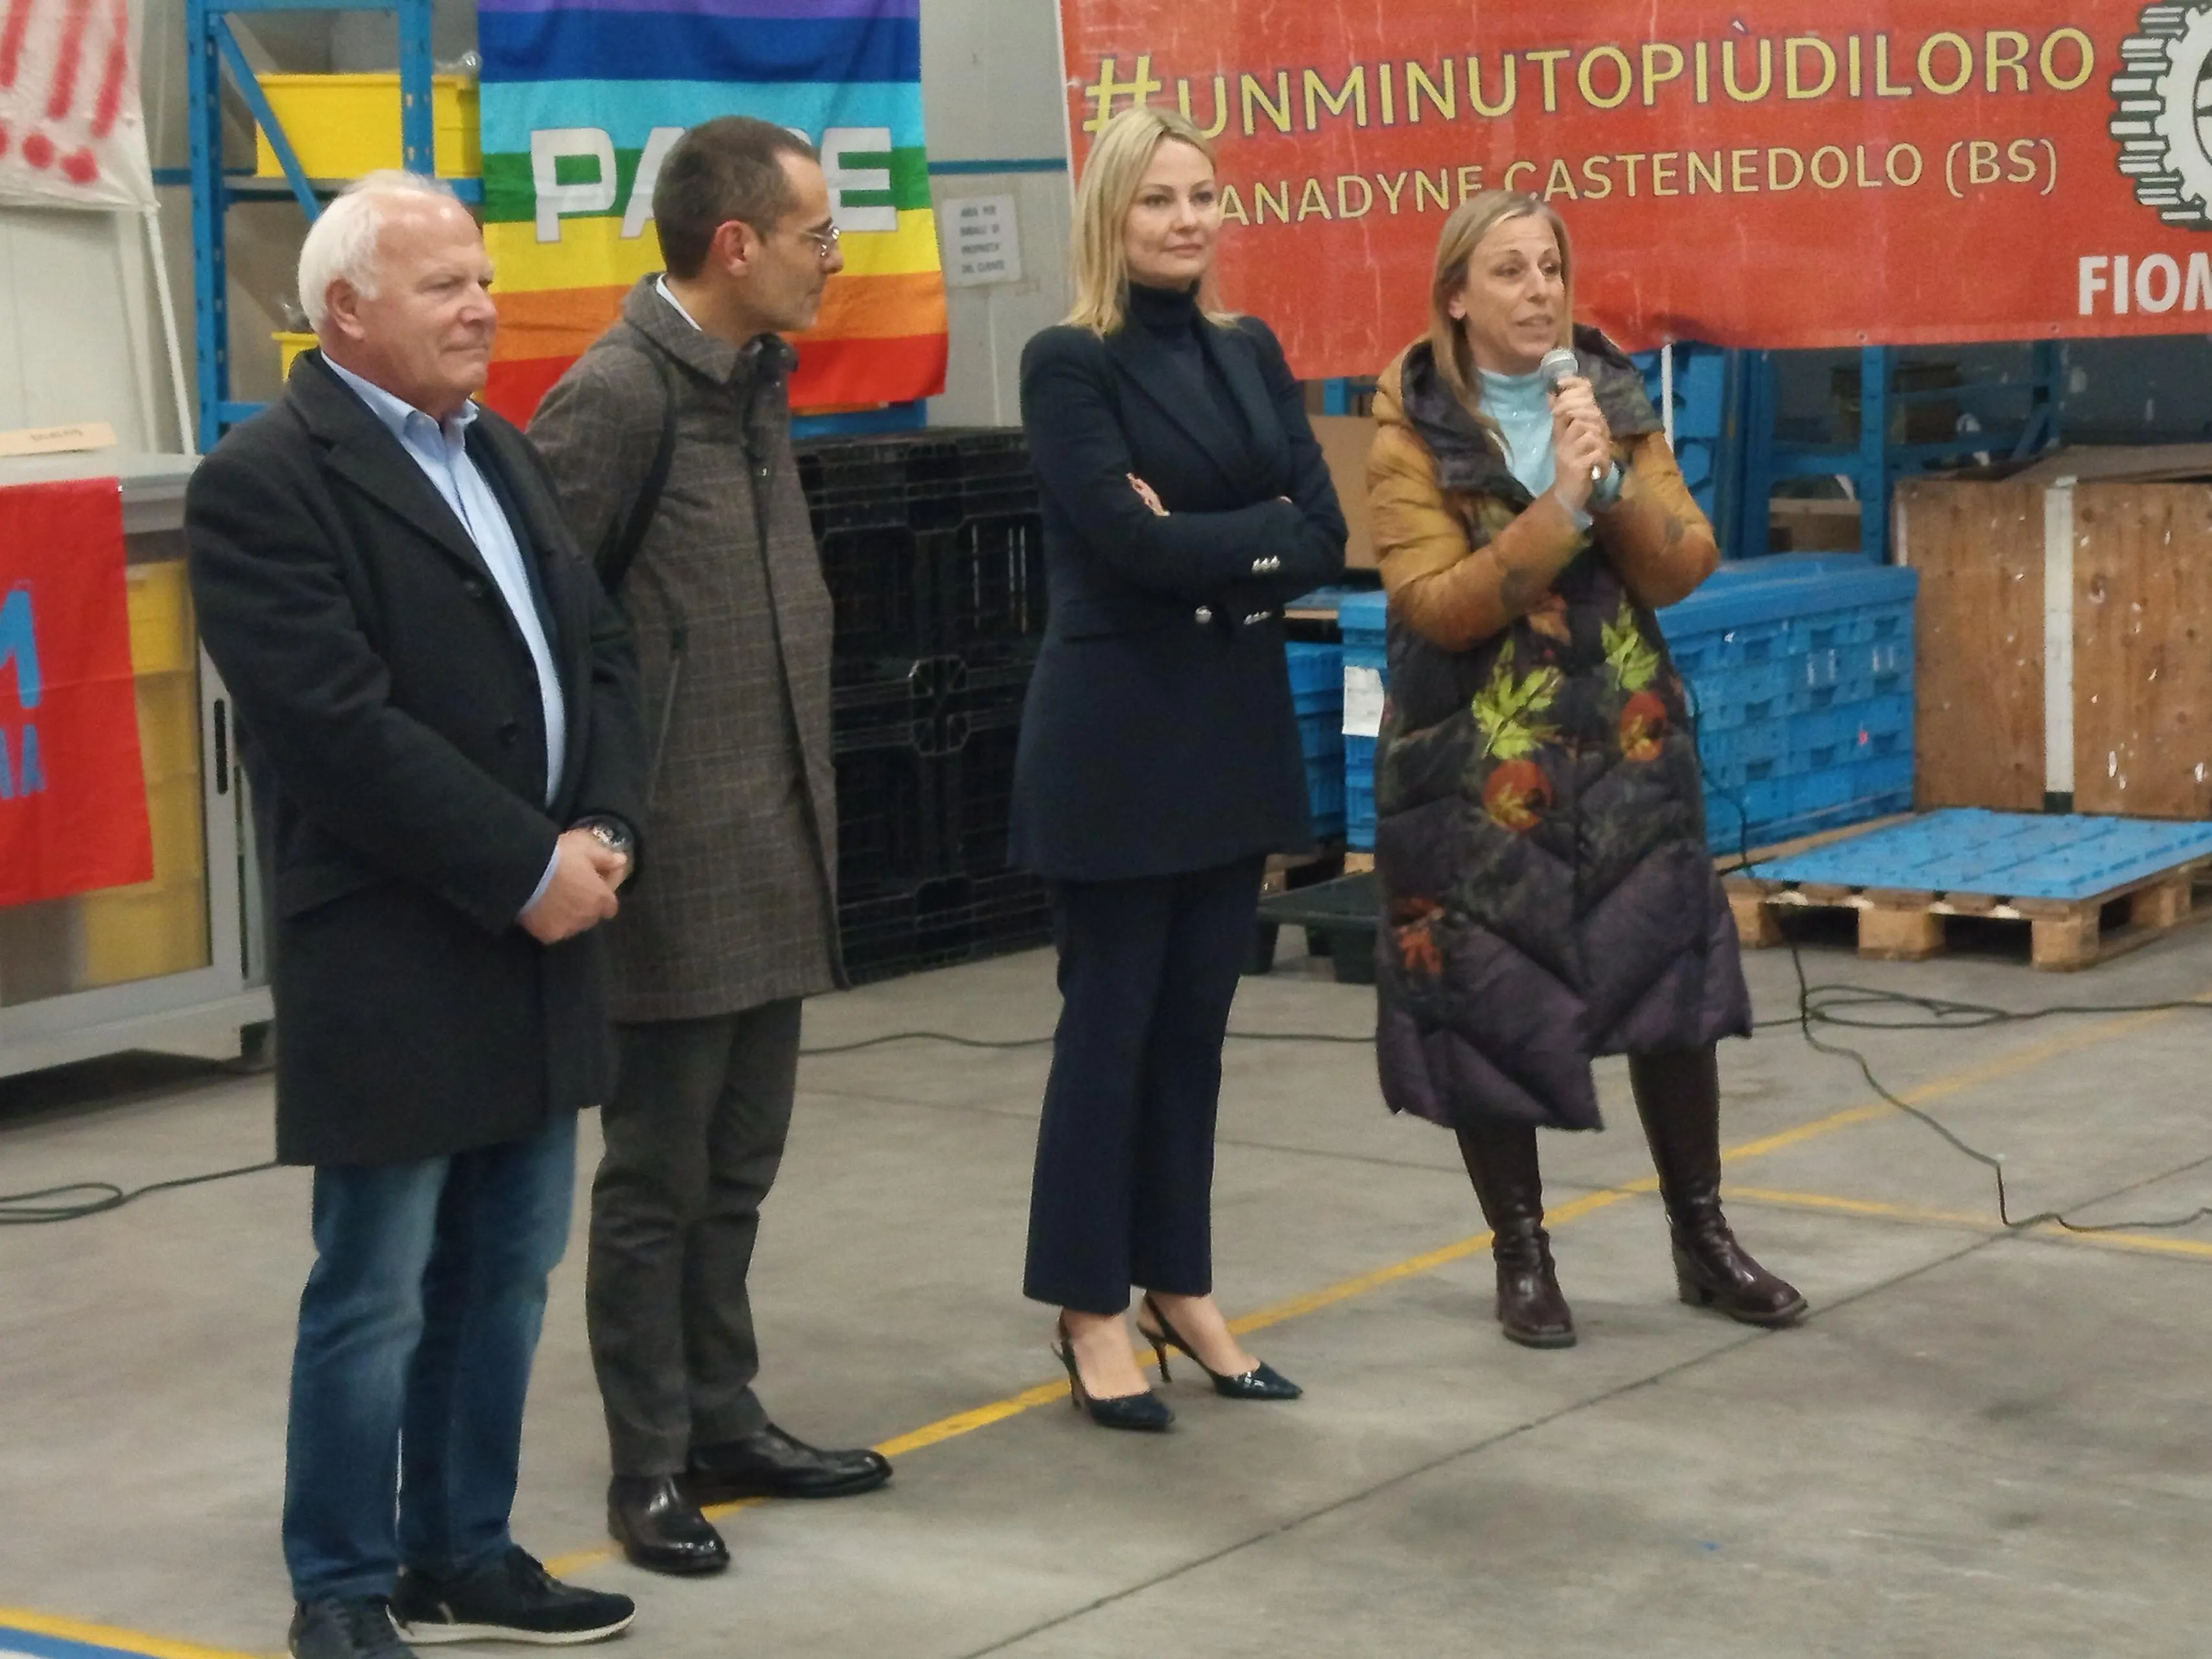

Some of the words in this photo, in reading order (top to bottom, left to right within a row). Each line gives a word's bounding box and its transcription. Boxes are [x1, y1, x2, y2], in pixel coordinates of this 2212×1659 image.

[530, 127, 898, 243] PE
[1219, 166, 1483, 226] ANADYNE
[1504, 143, 1923, 202] CASTENEDOLO
[1946, 139, 2058, 198] (BS)
